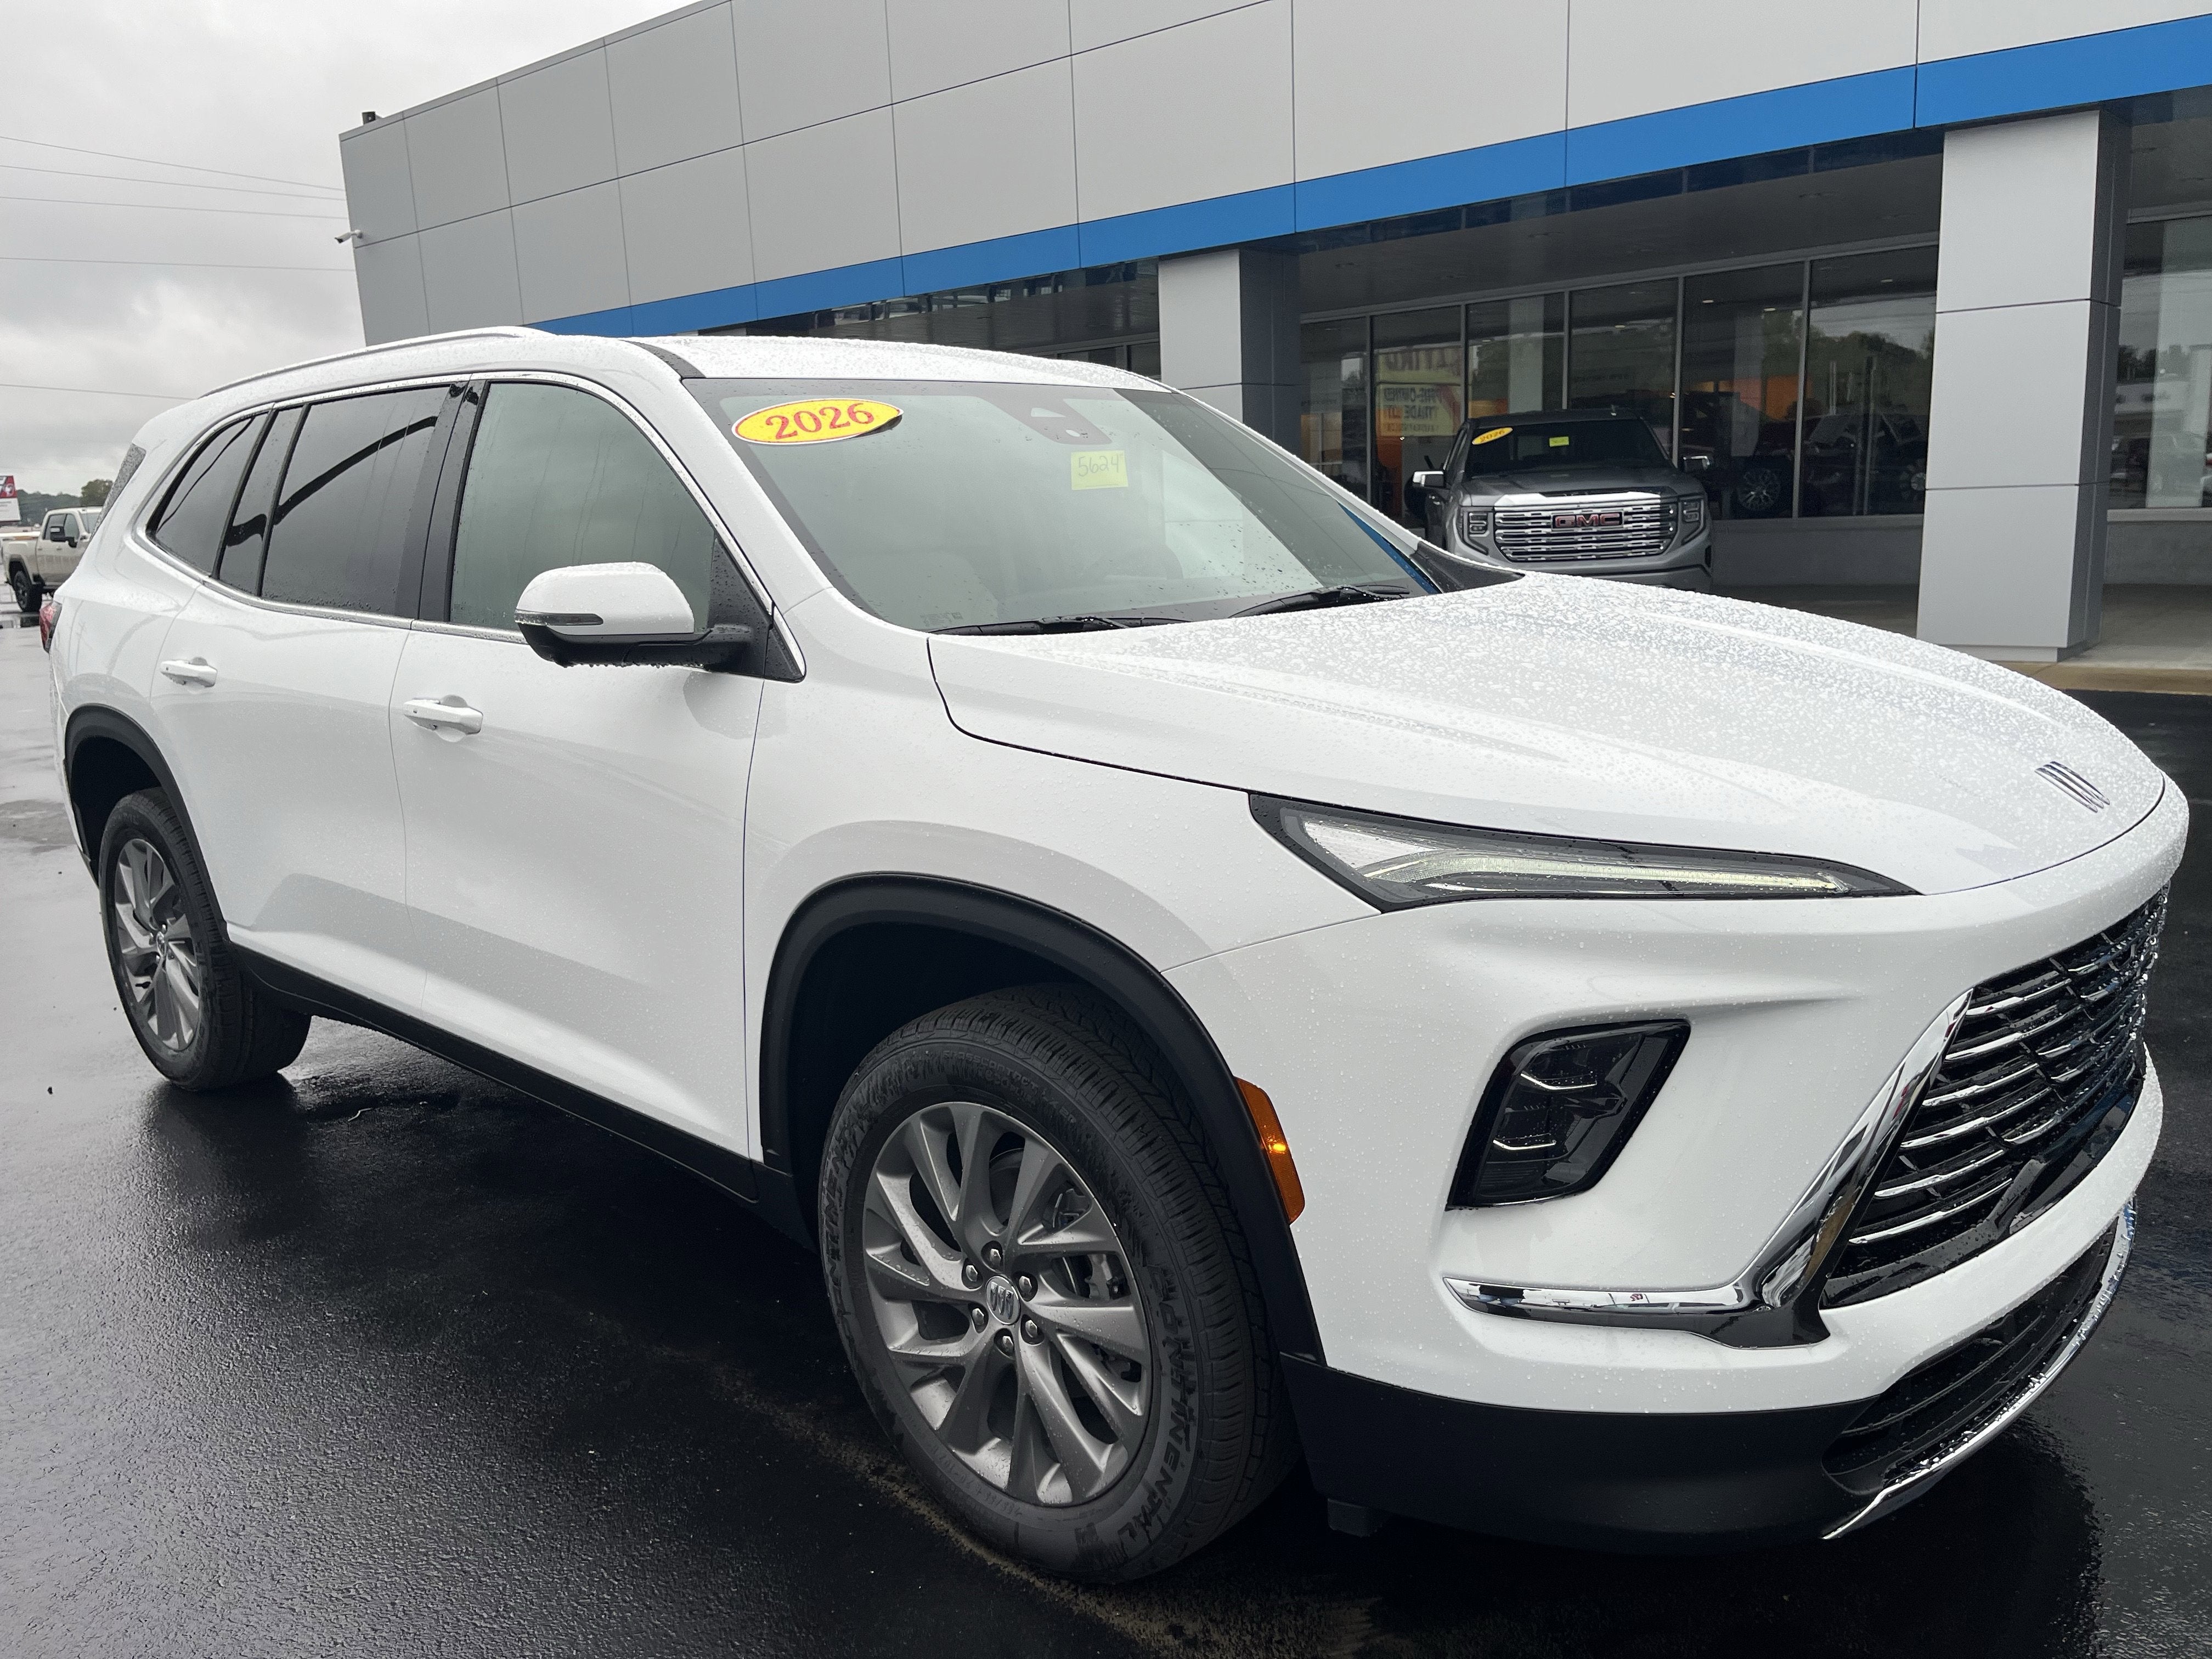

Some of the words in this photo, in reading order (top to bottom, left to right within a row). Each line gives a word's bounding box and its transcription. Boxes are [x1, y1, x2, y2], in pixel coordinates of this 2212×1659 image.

[765, 403, 874, 439] 2026
[1078, 455, 1119, 477] 5624
[1555, 512, 1620, 528] GMC
